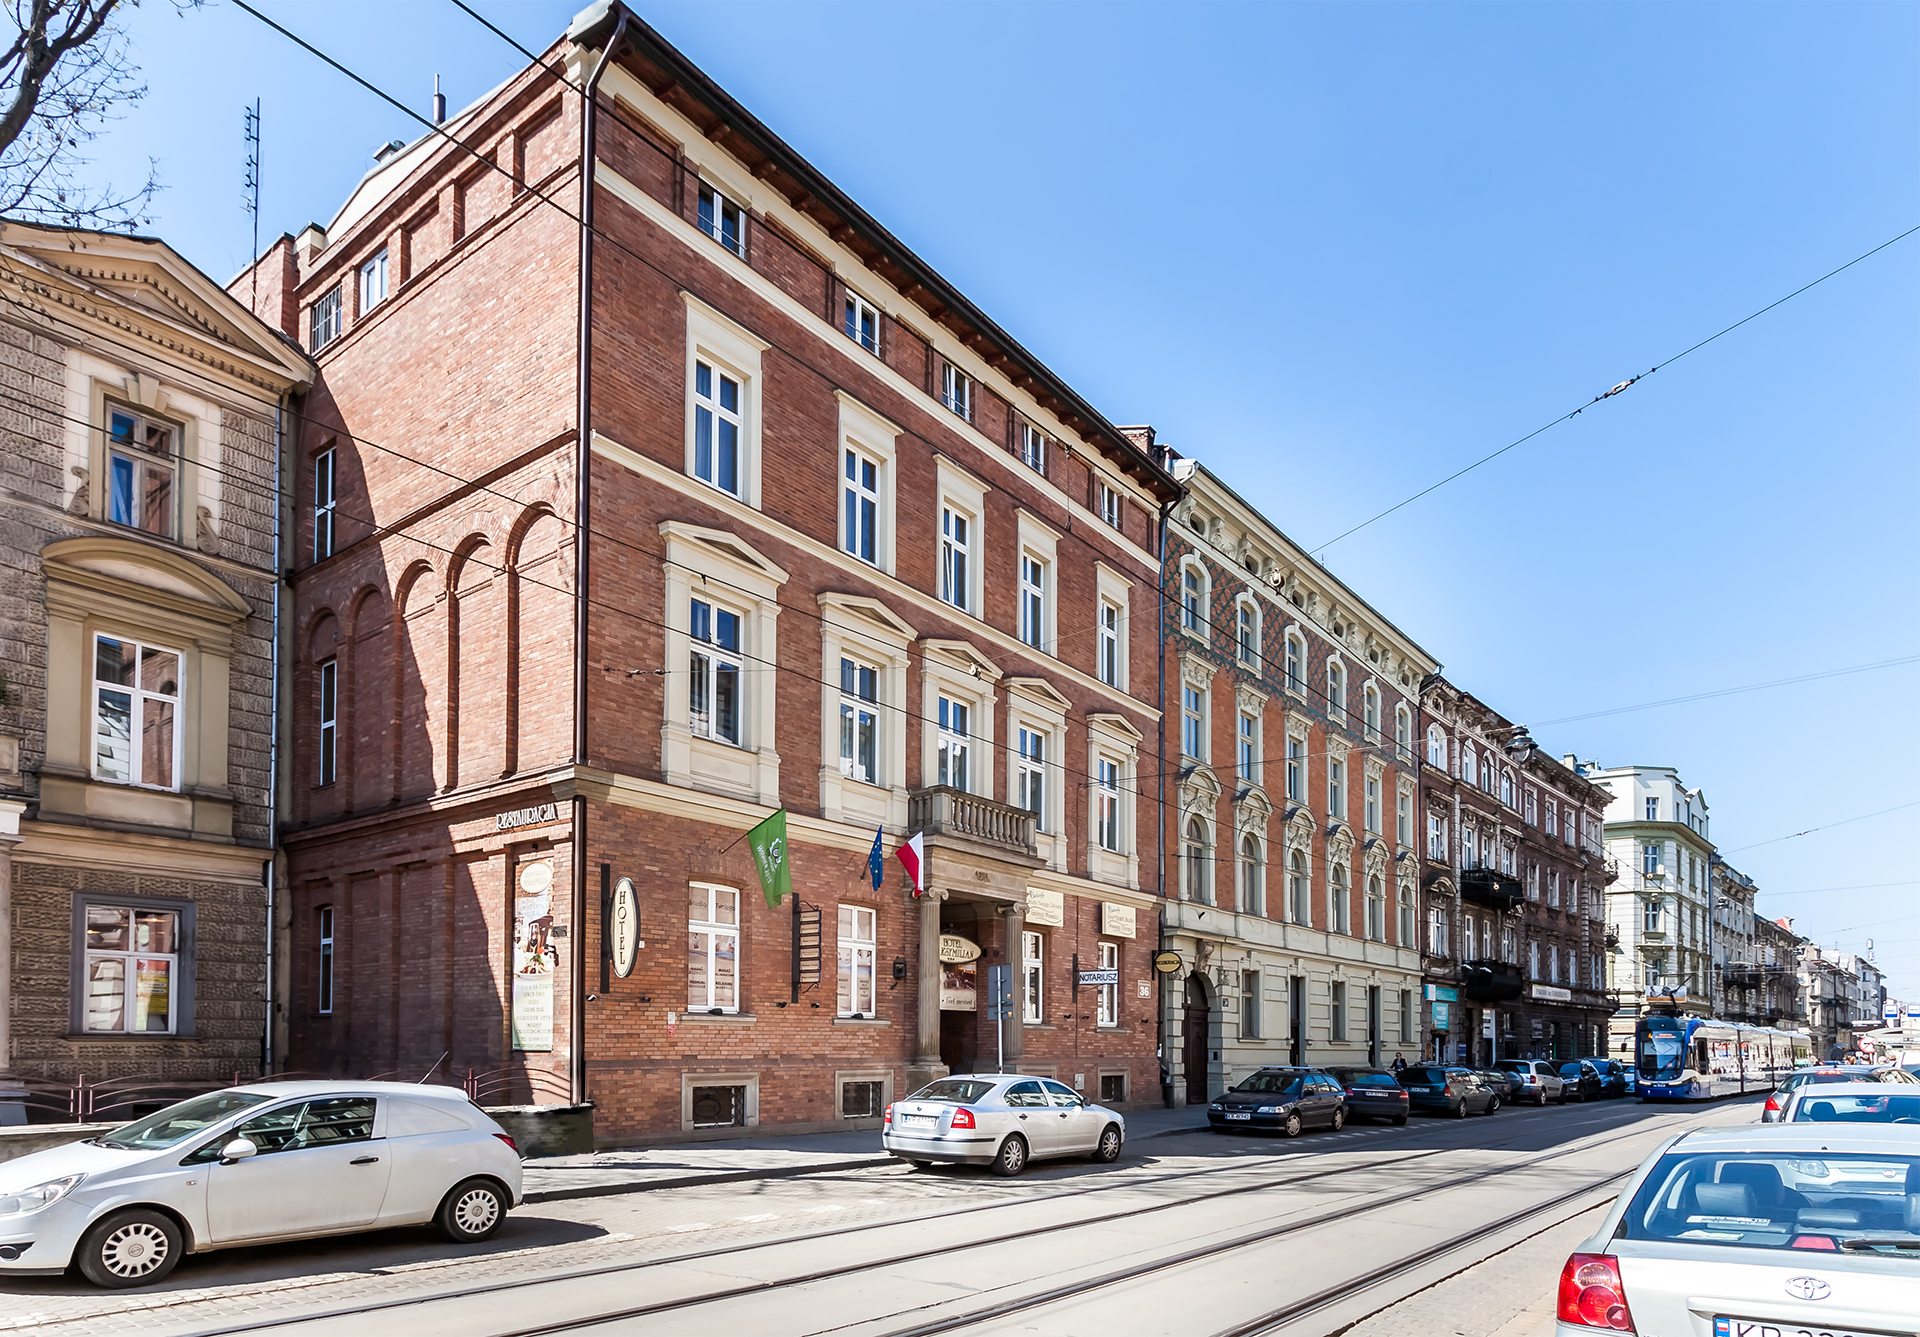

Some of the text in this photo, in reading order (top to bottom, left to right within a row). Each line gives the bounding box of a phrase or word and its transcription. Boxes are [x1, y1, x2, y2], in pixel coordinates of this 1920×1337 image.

[764, 869, 773, 884] 2015
[617, 890, 627, 965] HOTEL
[940, 947, 974, 958] KSYMILIAN
[1079, 973, 1117, 982] NOTARIUSZ
[1139, 986, 1149, 996] 36
